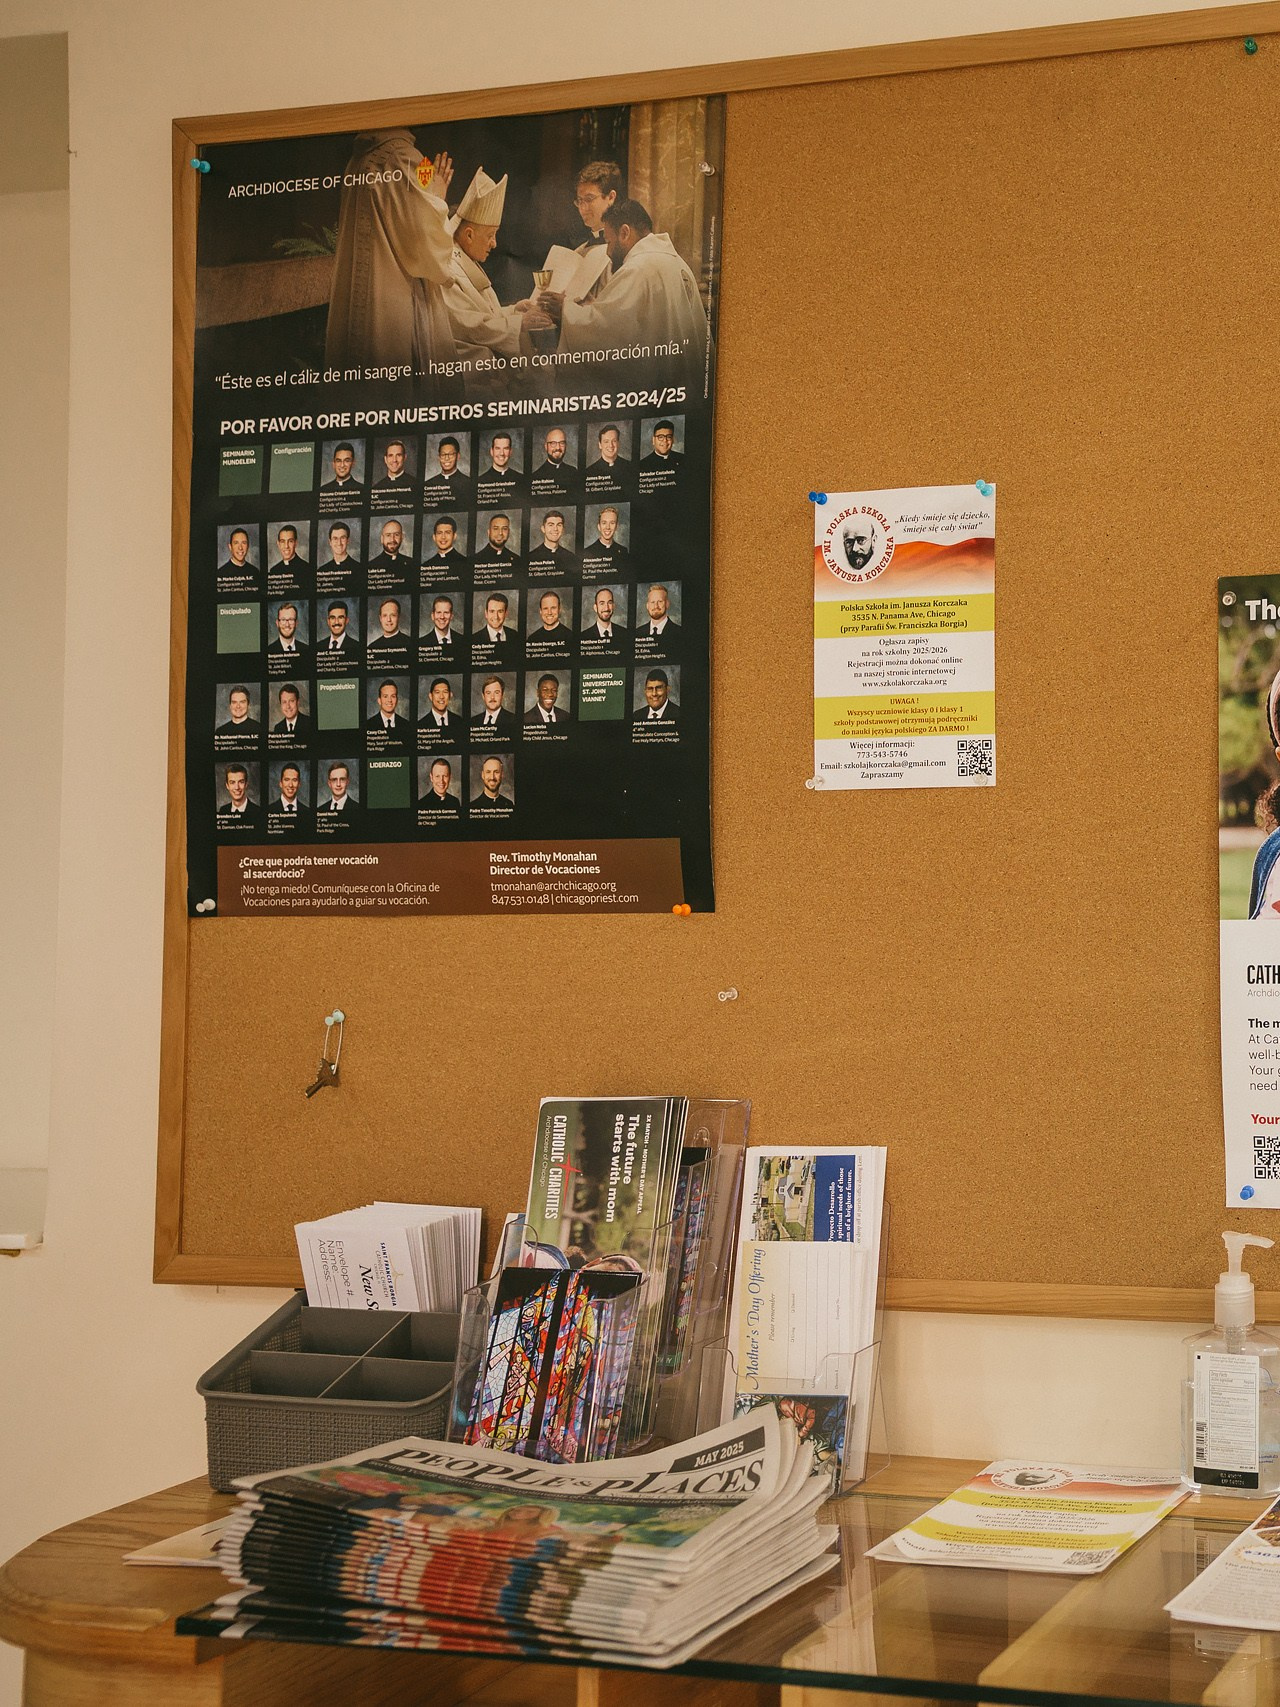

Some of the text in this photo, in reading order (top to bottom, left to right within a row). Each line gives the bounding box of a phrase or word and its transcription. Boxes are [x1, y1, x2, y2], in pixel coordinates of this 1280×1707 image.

[228, 170, 402, 198] ARCHDIOCESE OF CHICAGO
[256, 376, 272, 388] es
[274, 370, 287, 386] el
[290, 369, 320, 385] cáliz
[323, 367, 341, 383] de
[344, 365, 361, 381] mi
[364, 365, 412, 382] sangre
[429, 359, 472, 377] hagan
[475, 356, 507, 371] esto
[510, 356, 528, 368] en
[532, 348, 650, 367] conmemoración
[220, 386, 686, 435] POR FAVOR ORE POR NUESTROS SEMINARISTAS 2024/25
[222, 450, 255, 458] SEMINARIO
[274, 446, 312, 455] Configuración
[827, 506, 890, 536] POLSKA SZKOŁA
[922, 513, 947, 523] śmieje
[948, 512, 959, 522] się
[960, 511, 990, 520] dziecko,
[827, 536, 893, 582] JANUSZA KORCZAKA
[220, 607, 252, 616] Discipulado
[865, 602, 889, 610] Szkoła
[903, 601, 931, 610] Janusza
[933, 599, 968, 607] Korczaka
[852, 613, 870, 621] 3535
[926, 610, 956, 618] Chicago
[320, 683, 356, 691] Propedéutico
[862, 678, 948, 687] www.szkolakorczaka.org
[857, 750, 908, 758] 773-543-5746
[844, 759, 946, 769] szkolajkorczaka@gmail.com
[490, 851, 597, 864] Rev. Timothy Monahan
[490, 864, 601, 875] Director de Vocaciones
[490, 881, 617, 892] tmonahan@archchicago.org
[492, 893, 639, 906] 847.531.0148 chicagopriest.com
[1251, 1114, 1280, 1125] Your
[623, 1114, 640, 1184] The future
[545, 1115, 567, 1220] CATHOLIC CHARITIES
[606, 1114, 624, 1222] starts with mom
[336, 1240, 350, 1287] Envelope
[384, 1260, 392, 1284] FRANCIS
[748, 1248, 766, 1294] Offering
[359, 1264, 373, 1296] New
[747, 1297, 764, 1326] Day
[694, 1440, 744, 1468] MAY 2025
[379, 1448, 576, 1487] PEOPLE
[586, 1458, 765, 1495] PLACES
